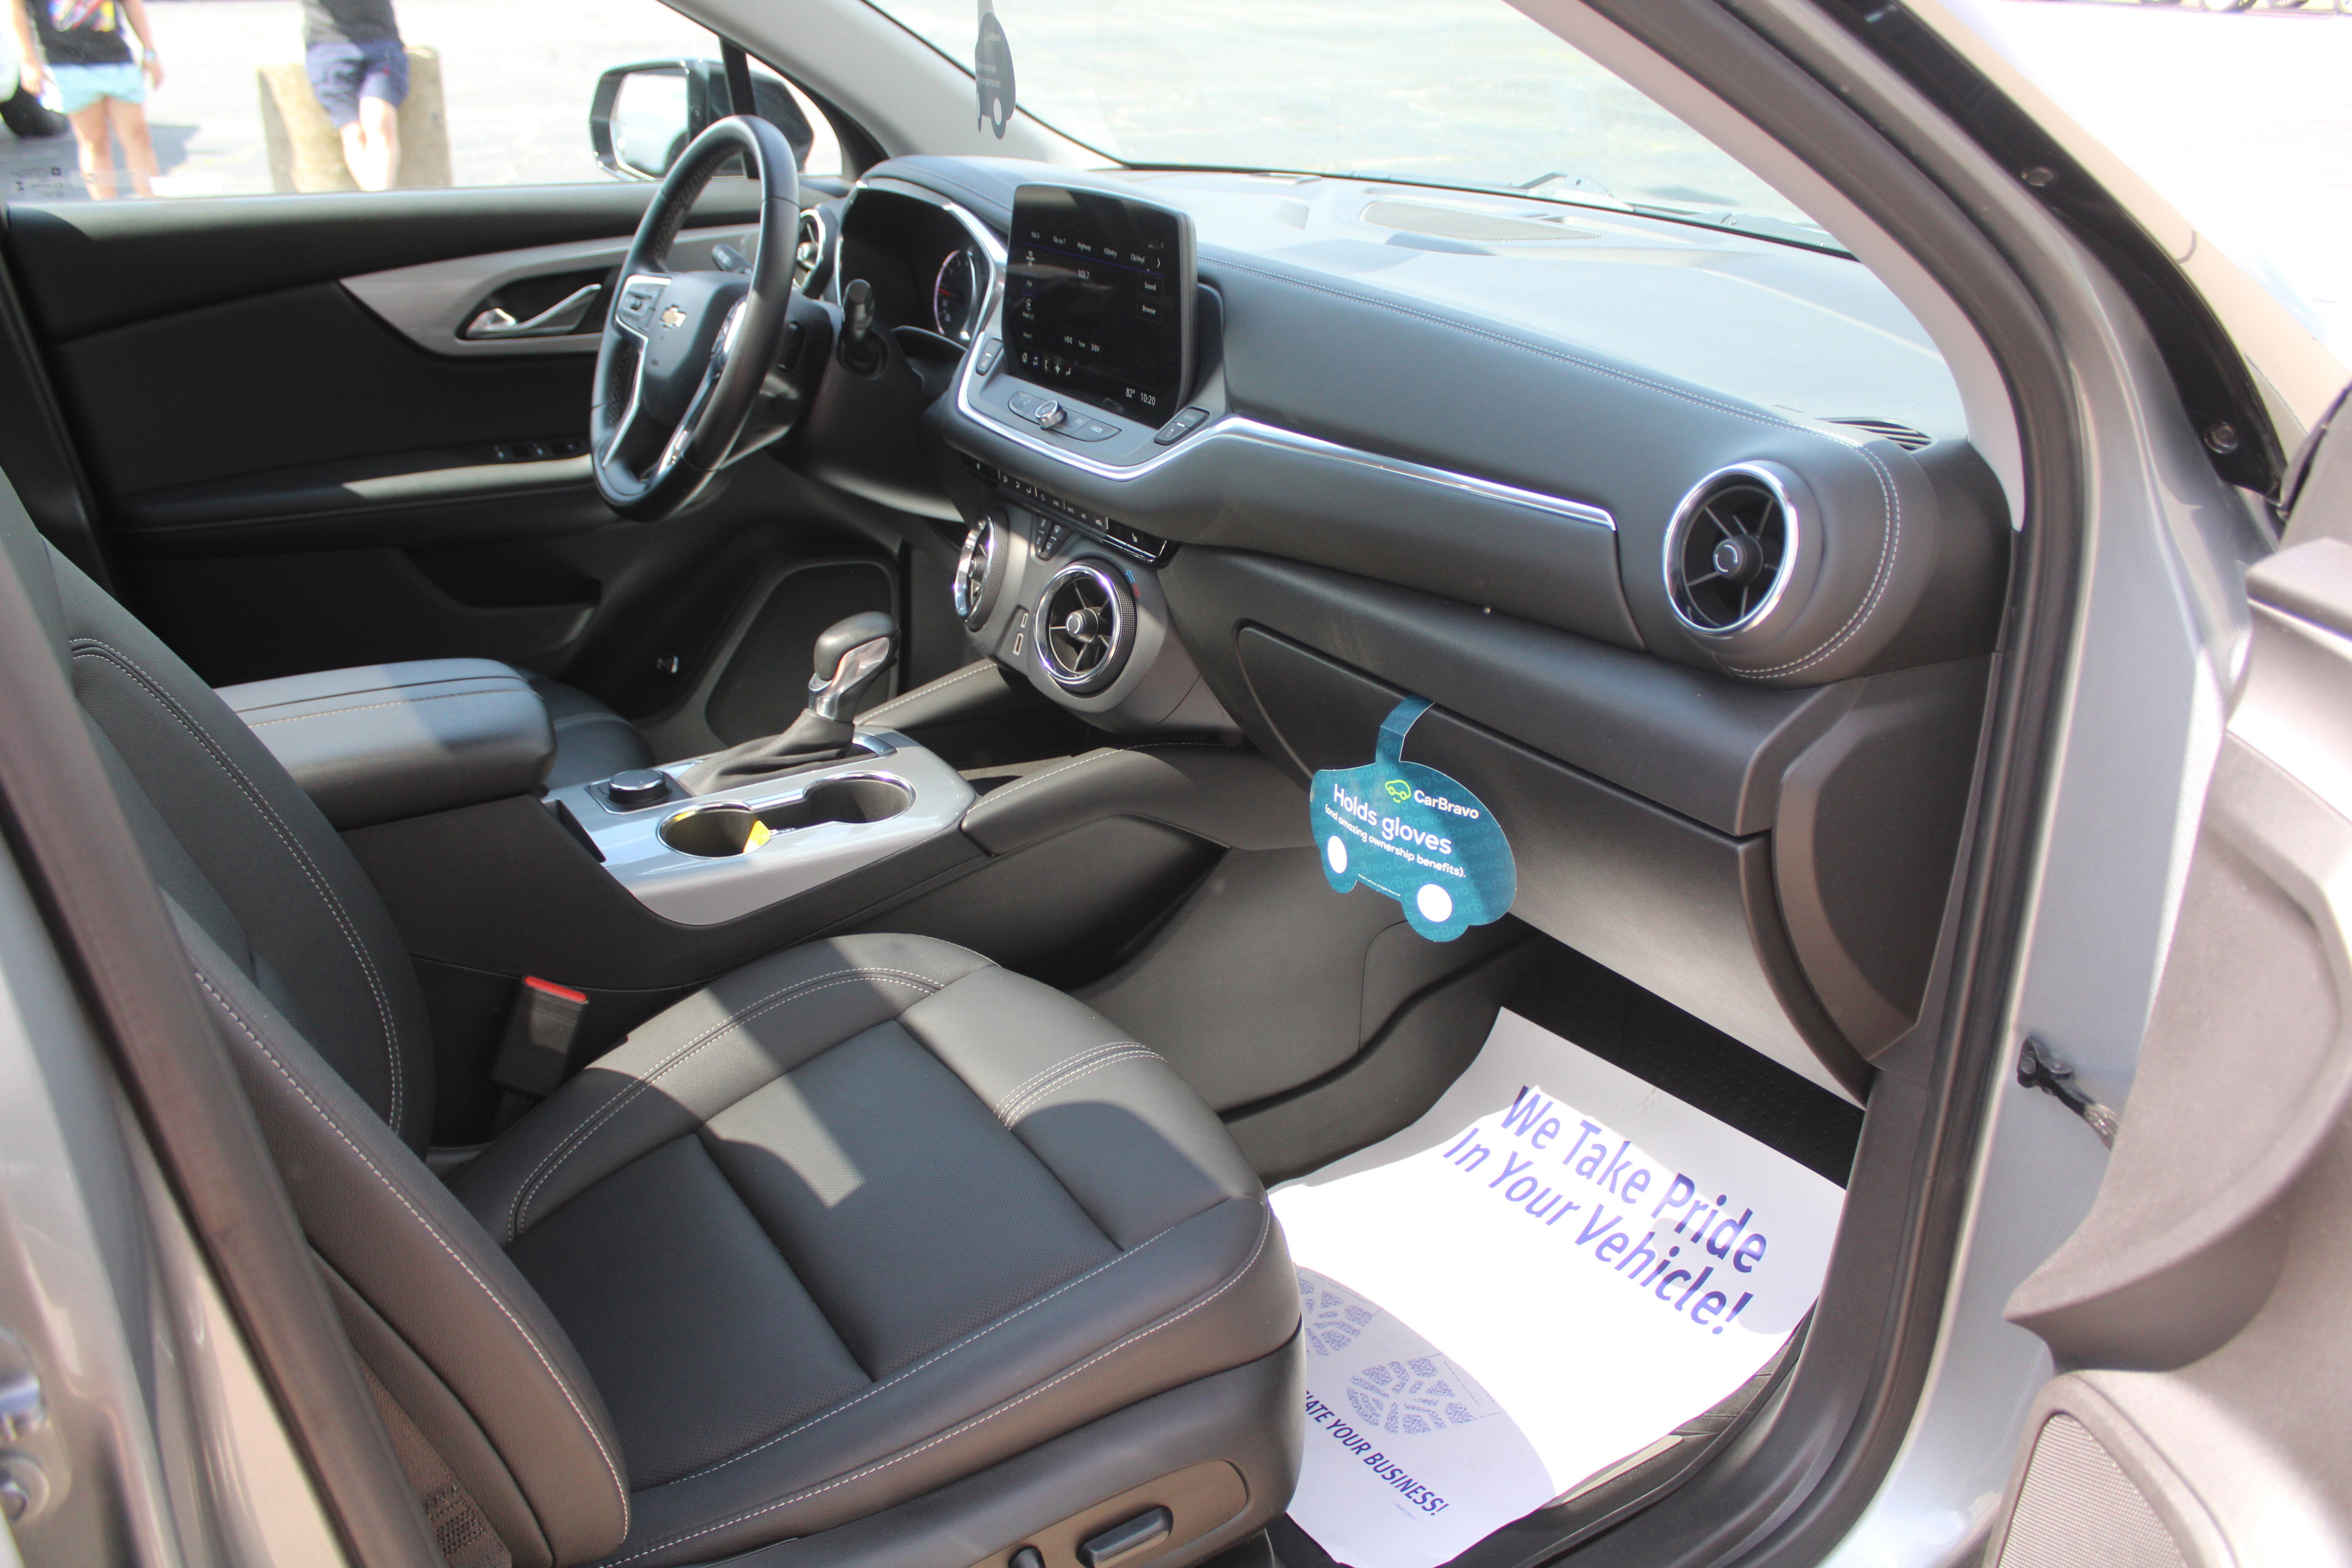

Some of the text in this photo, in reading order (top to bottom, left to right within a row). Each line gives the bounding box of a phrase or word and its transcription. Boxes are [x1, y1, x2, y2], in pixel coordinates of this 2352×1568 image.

[1078, 269, 1089, 279] 103.7
[1145, 281, 1156, 291] Sound
[1142, 305, 1156, 314] Browse
[1140, 392, 1156, 405] 10:20
[1334, 783, 1452, 855] Holds gloves
[1414, 789, 1479, 819] CarBravo
[1325, 803, 1466, 878] (and amazing ownership benefits).
[1500, 1085, 1768, 1273] We Take Pride
[1442, 1127, 1754, 1335] In Your Vehicle!
[1325, 1418, 1372, 1455] YOUR
[1363, 1452, 1449, 1516] BUSINESS!
